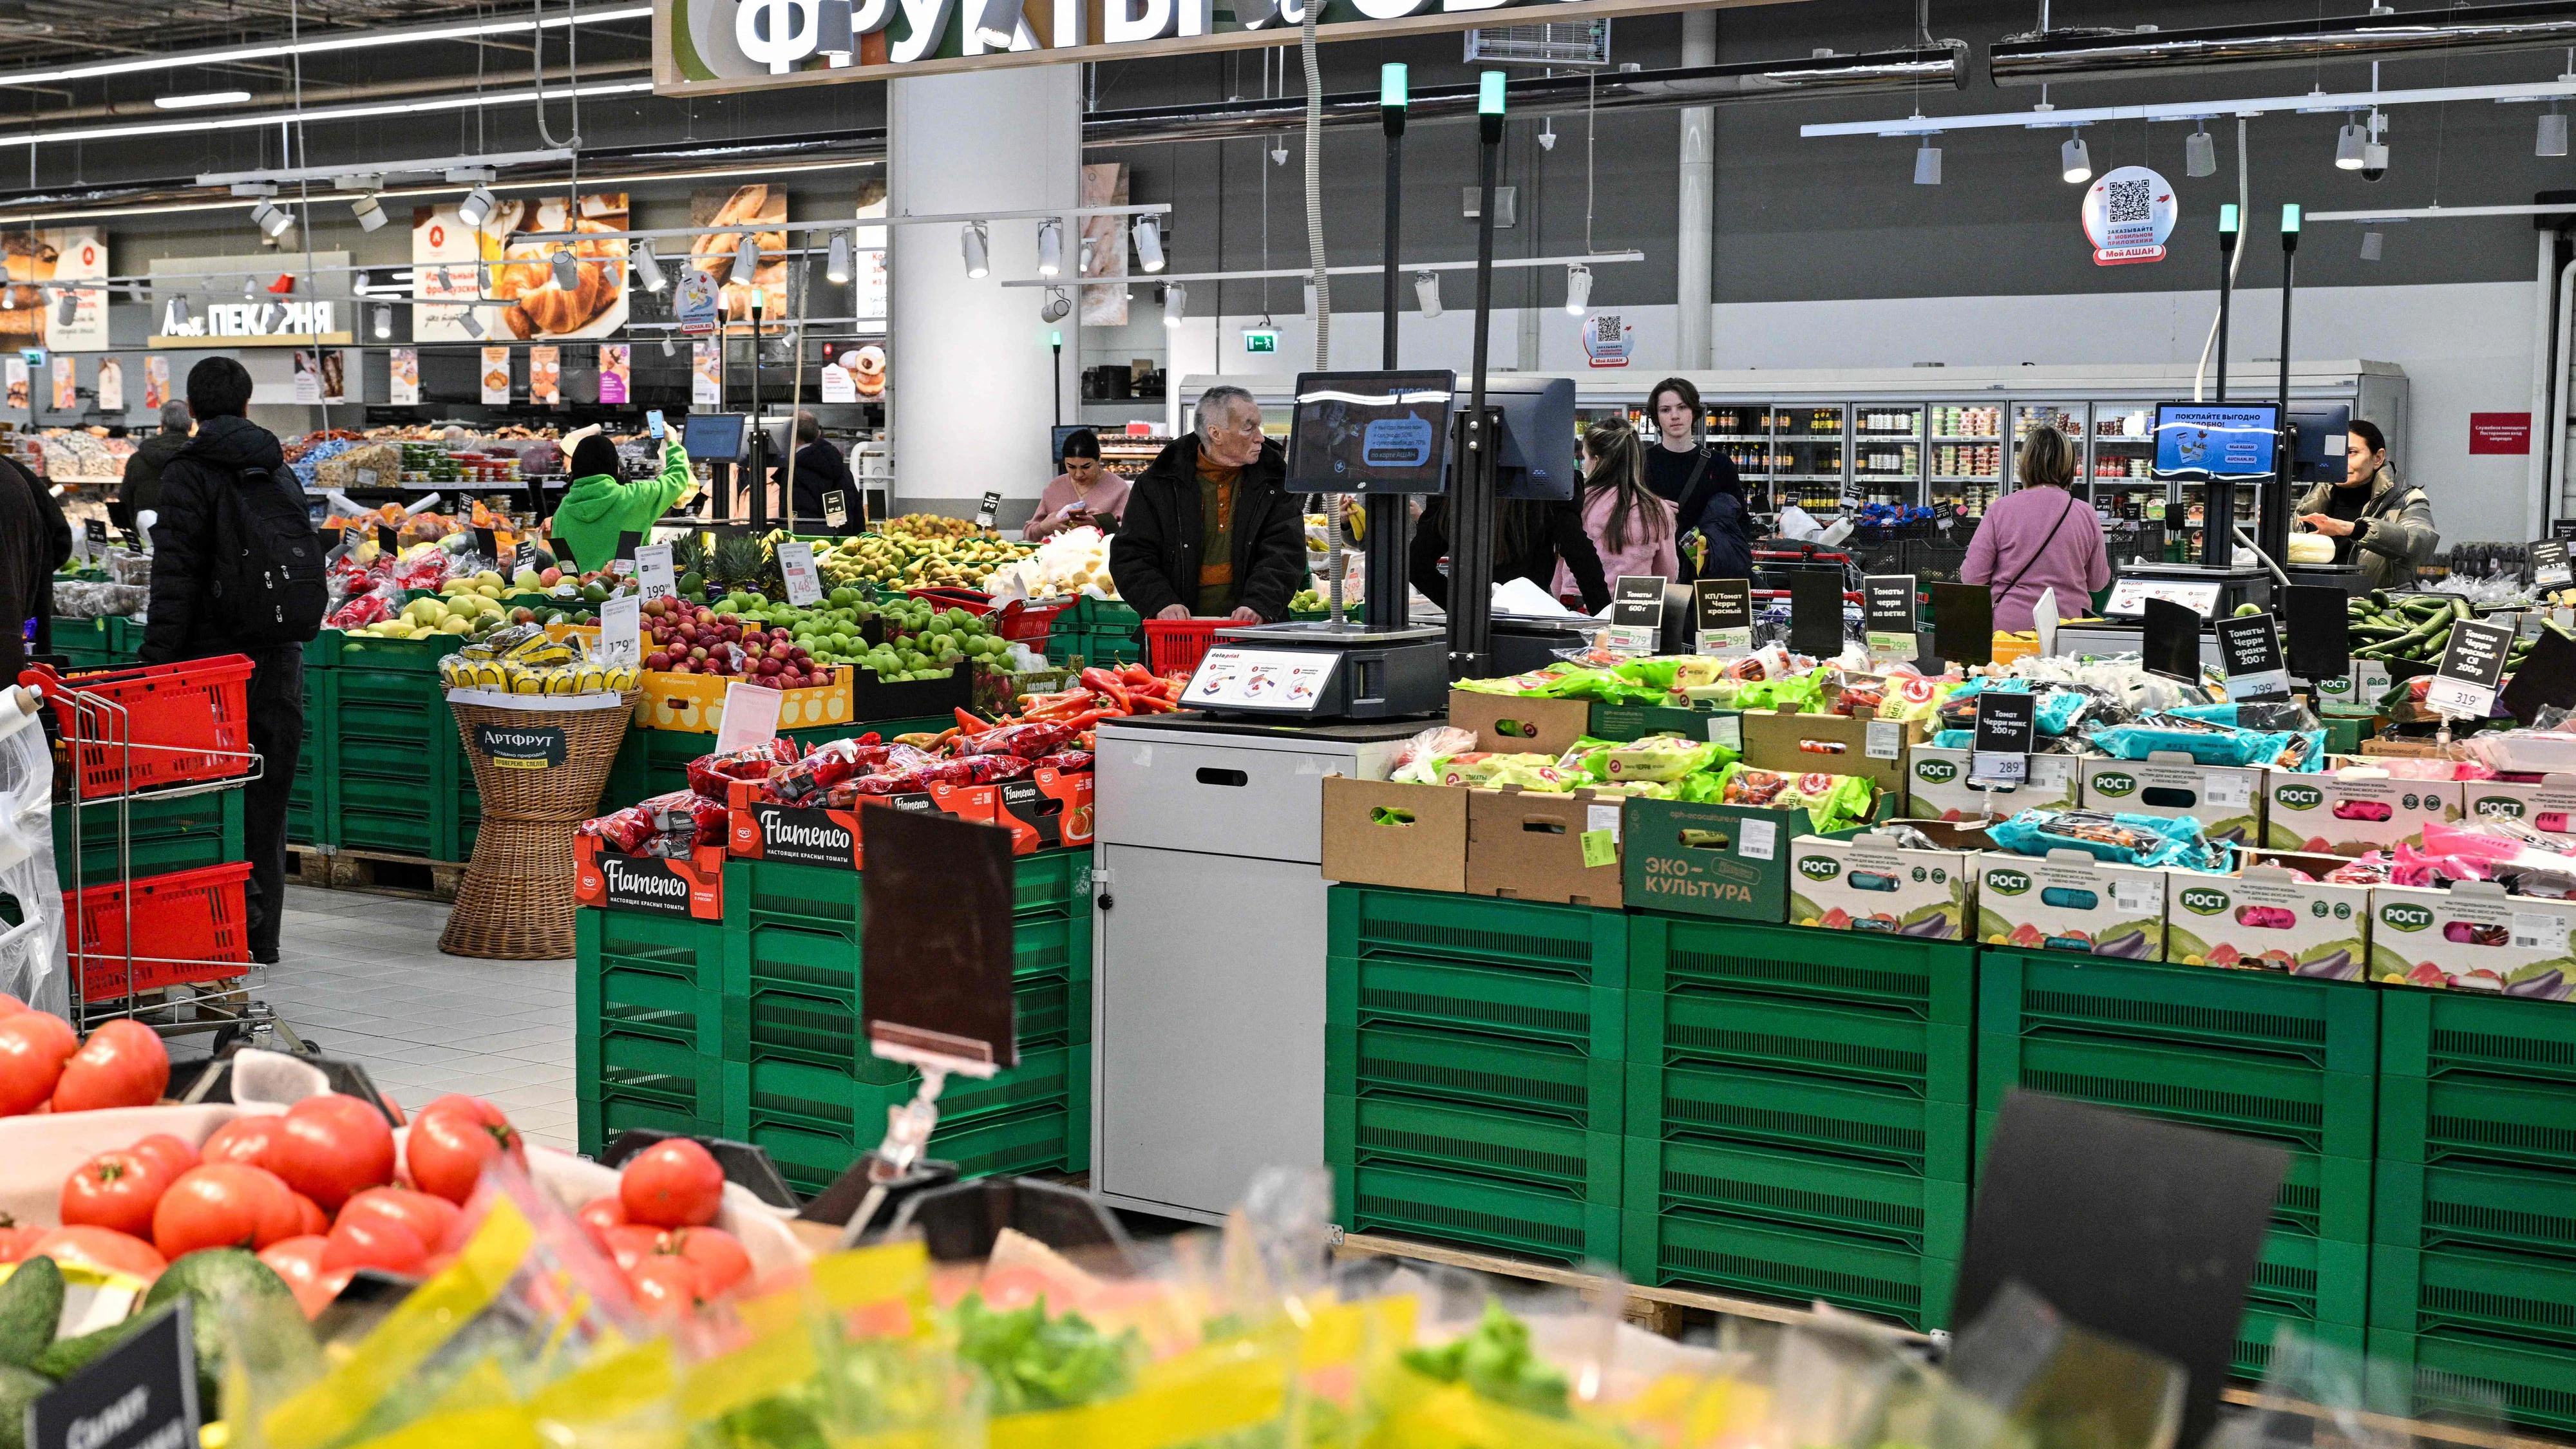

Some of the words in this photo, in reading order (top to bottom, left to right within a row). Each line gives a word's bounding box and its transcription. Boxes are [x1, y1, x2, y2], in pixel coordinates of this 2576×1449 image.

[2107, 226, 2153, 234] ЗАКАЗЫВАЙТЕ
[2126, 248, 2154, 256] АШАН
[426, 269, 475, 282] Идльный
[647, 585, 665, 598] 199
[792, 581, 810, 593] 148
[2228, 627, 2265, 638] Томаты
[2465, 629, 2497, 642] Томаты
[1631, 635, 1647, 645] 279
[1728, 636, 1746, 645] 299
[1891, 641, 1908, 650] 299
[2234, 637, 2264, 647] Черри
[2465, 638, 2492, 650] Черри
[2235, 646, 2268, 657] оранж
[2456, 647, 2494, 659] красные
[2241, 656, 2260, 665] 200
[2456, 663, 2483, 676] 200гр
[1027, 679, 1056, 692] КАЗАЧИЙ
[2251, 683, 2272, 695] 299
[2321, 680, 2348, 688] РОСТ
[2455, 692, 2476, 705] 319
[1984, 718, 2007, 726] Черри
[494, 749, 516, 757] создано
[517, 750, 546, 759] природой
[1920, 764, 1953, 776] РОСТ
[2000, 762, 2019, 773] 289
[2096, 777, 2132, 790] РОСТ
[1003, 786, 1036, 800] Flamenco
[2280, 790, 2318, 802] РОСТ
[895, 797, 929, 811] Flamenco
[2479, 802, 2520, 815] РОСТ
[760, 810, 849, 849] Flamenco
[767, 849, 799, 858] НАСТОЯЩИЕ
[1645, 857, 1703, 876] ЭКО-
[1802, 860, 1836, 873] РОСТ
[603, 859, 687, 896] Flamenco
[1990, 874, 2027, 887] РОСТ
[1645, 876, 1752, 902] КУЛЬТУРА
[610, 897, 639, 905] НАСТОЯЩИЕ
[2185, 893, 2225, 907] РОСТ
[2386, 909, 2429, 923] РОСТ
